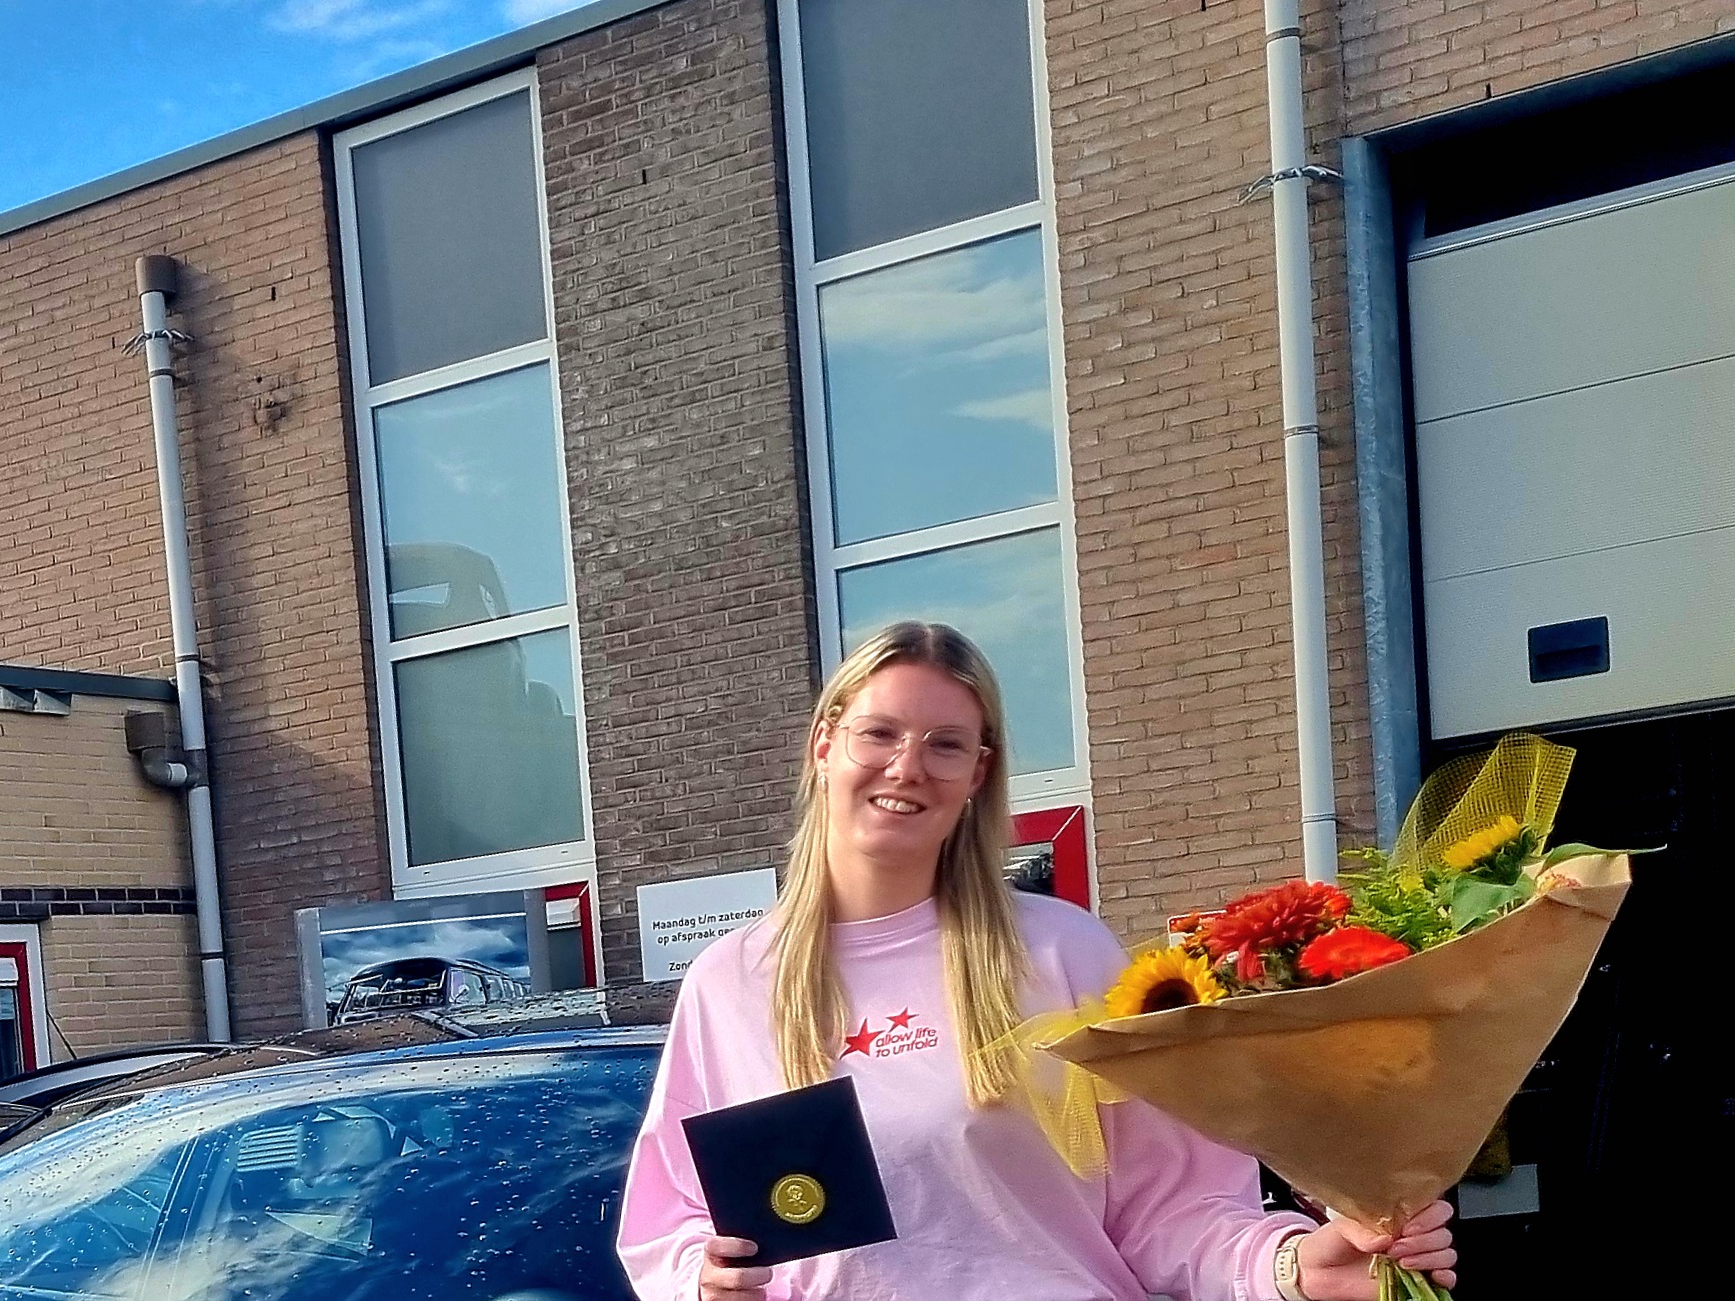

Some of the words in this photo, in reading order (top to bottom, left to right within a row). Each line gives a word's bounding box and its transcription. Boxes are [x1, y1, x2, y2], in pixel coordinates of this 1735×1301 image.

[652, 917, 696, 931] Maandag
[698, 914, 717, 926] t/m
[657, 934, 670, 946] op
[671, 928, 716, 943] afspraak
[875, 1030, 914, 1048] allow
[914, 1026, 937, 1039] life
[875, 1048, 891, 1058] to
[892, 1036, 938, 1055] unfold
